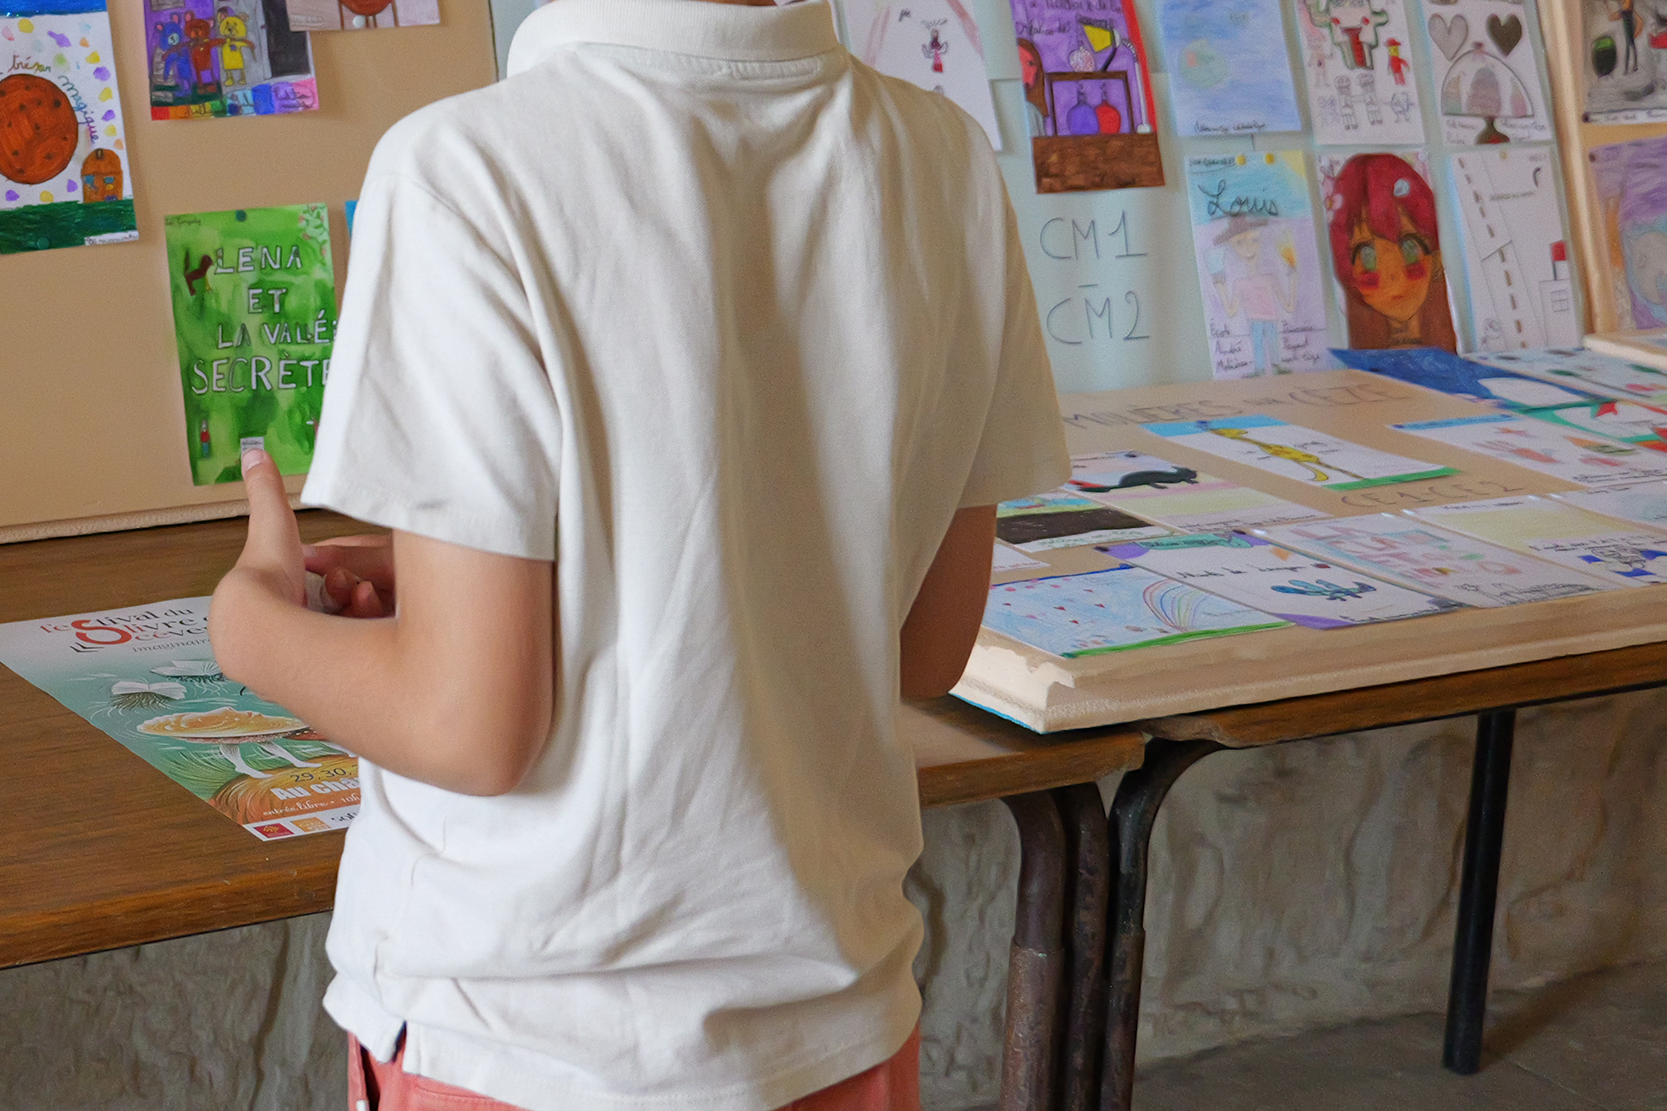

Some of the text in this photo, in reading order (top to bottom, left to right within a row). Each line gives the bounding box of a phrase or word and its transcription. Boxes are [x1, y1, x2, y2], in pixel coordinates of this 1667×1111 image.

[1038, 209, 1150, 261] CM1
[213, 245, 303, 276] LENA
[247, 287, 288, 315] ET
[1045, 290, 1151, 345] CM2
[216, 308, 336, 350] LA VALLÉ
